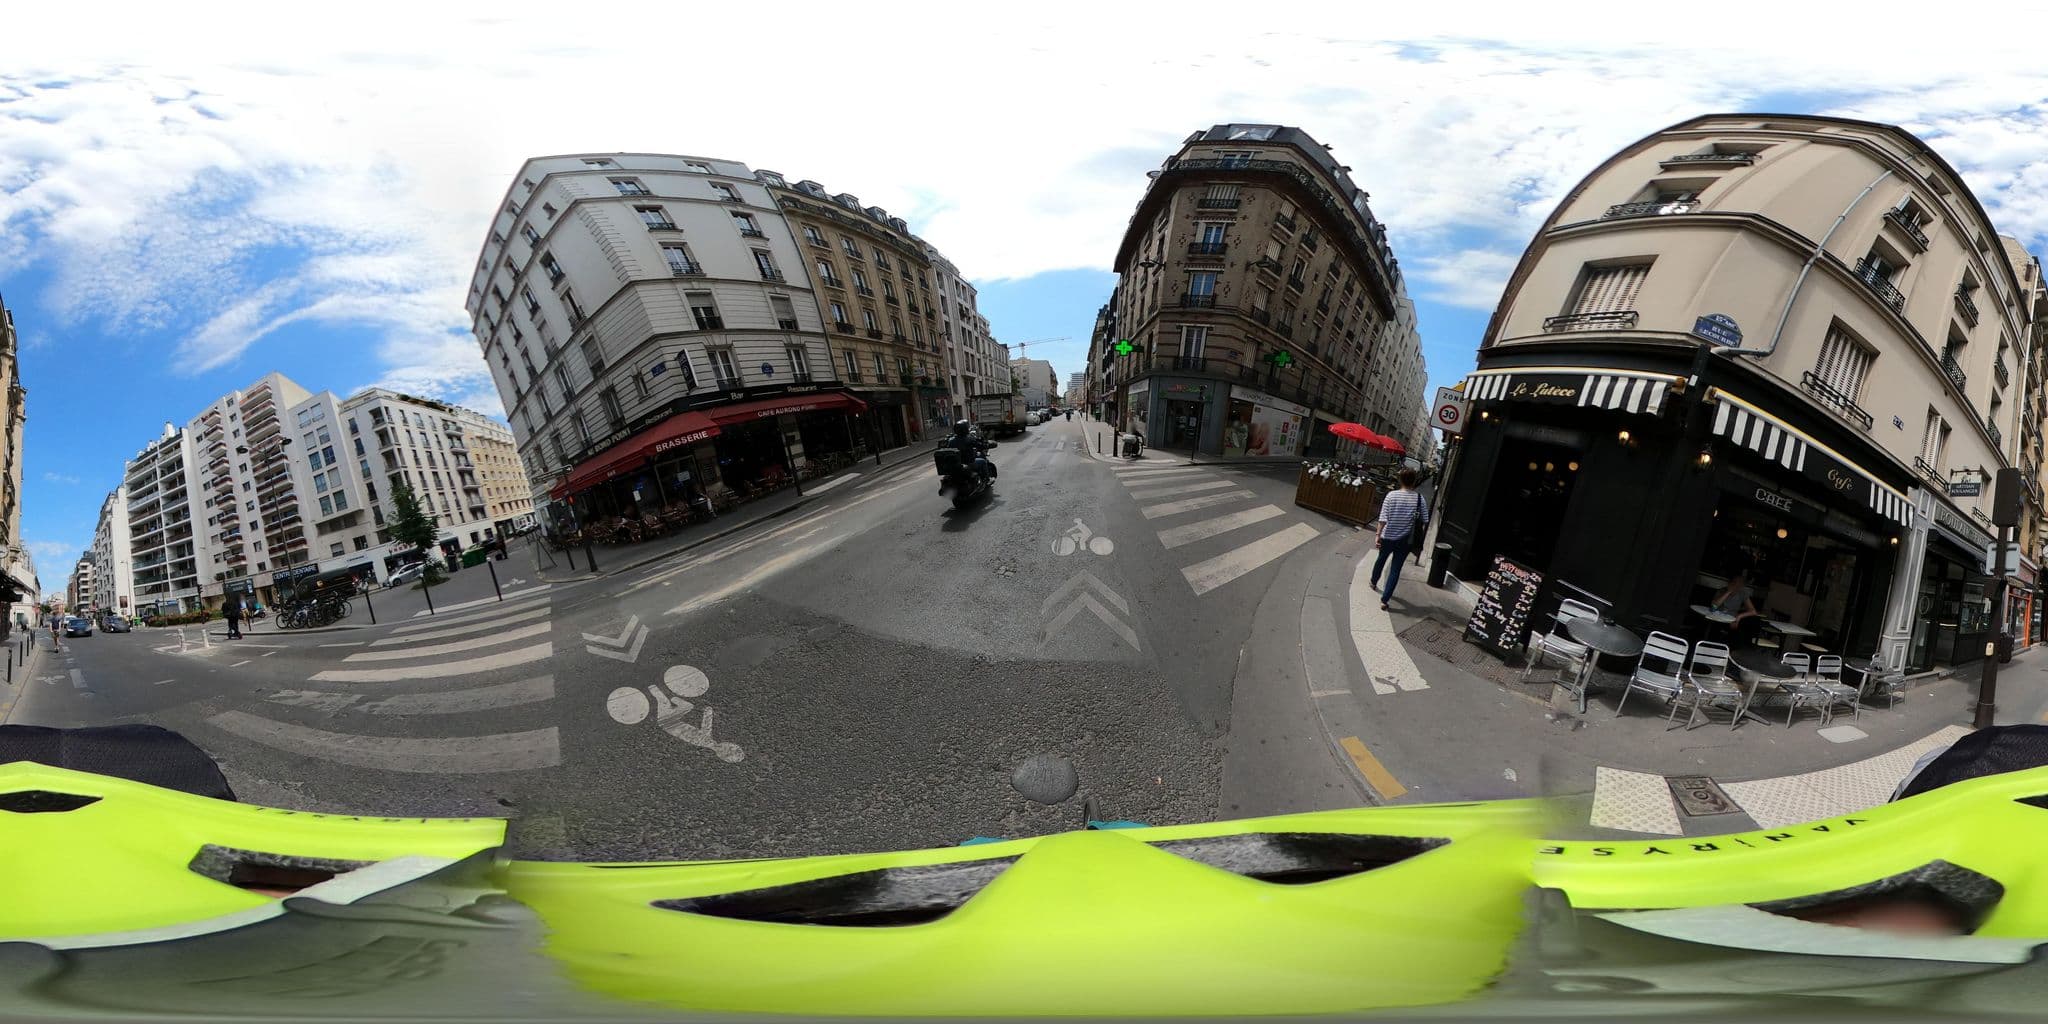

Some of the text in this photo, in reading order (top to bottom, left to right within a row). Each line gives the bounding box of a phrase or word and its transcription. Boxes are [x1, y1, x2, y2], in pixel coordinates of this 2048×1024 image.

[1509, 382, 1576, 398] Le Lutèce
[730, 392, 744, 400] Bar
[1442, 392, 1465, 403] ZONE
[1443, 409, 1456, 420] 30
[655, 430, 709, 452] BRASSERIE
